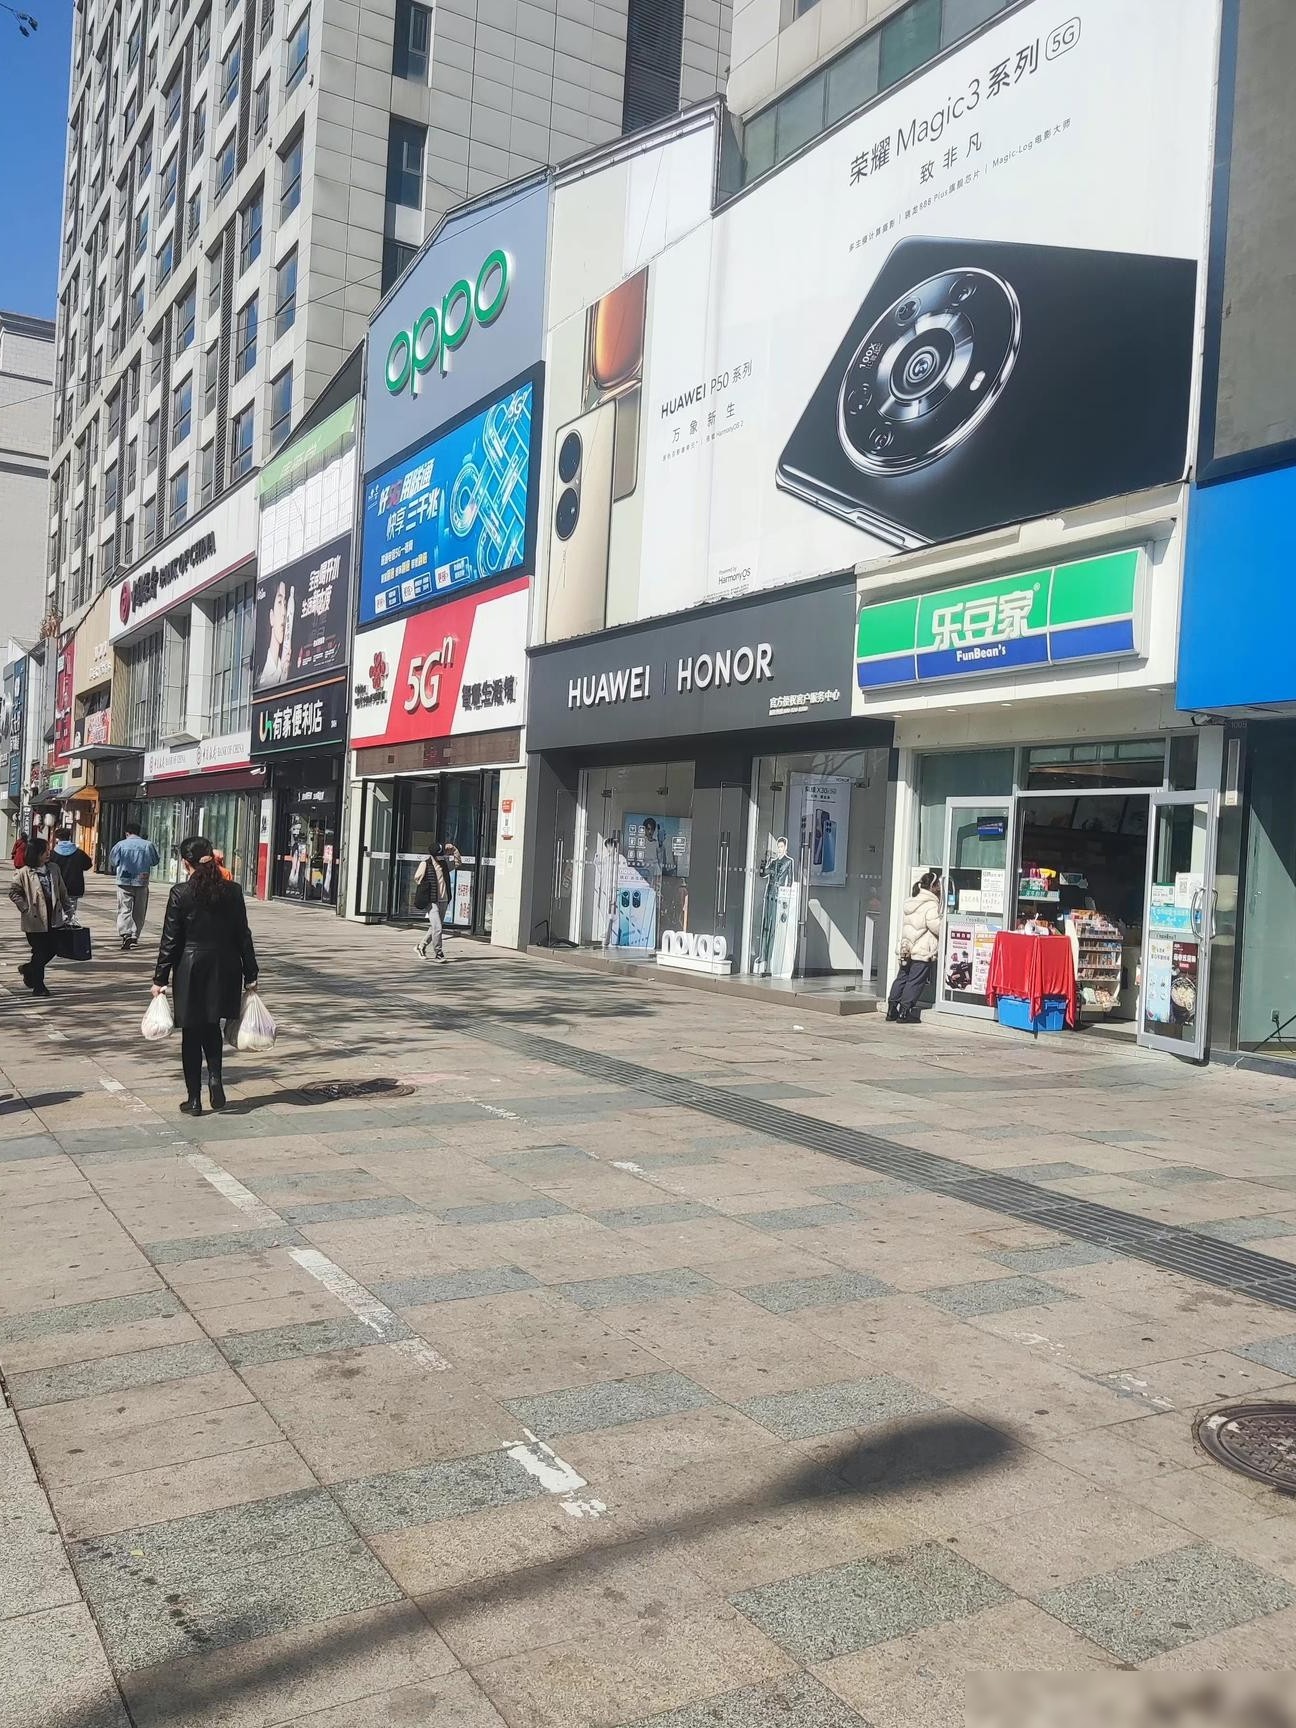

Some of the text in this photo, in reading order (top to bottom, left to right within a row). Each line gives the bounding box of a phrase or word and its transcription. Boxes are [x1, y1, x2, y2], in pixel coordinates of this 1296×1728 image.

[850, 25, 1076, 186] 荣耀 Magic3 系列 5G
[920, 132, 982, 185] 致非凡
[860, 342, 877, 368] 100X
[660, 359, 753, 420] HUAWEI P50 系列
[672, 401, 736, 444] 万象新生
[718, 568, 751, 585] HarmonyOS
[932, 590, 1034, 652] 乐豆家
[956, 644, 1006, 662] FunBean's
[568, 642, 774, 708] HUAWEI HONOR
[273, 698, 324, 740] 有家便利店
[770, 688, 840, 709] 官方授权客户服务中心
